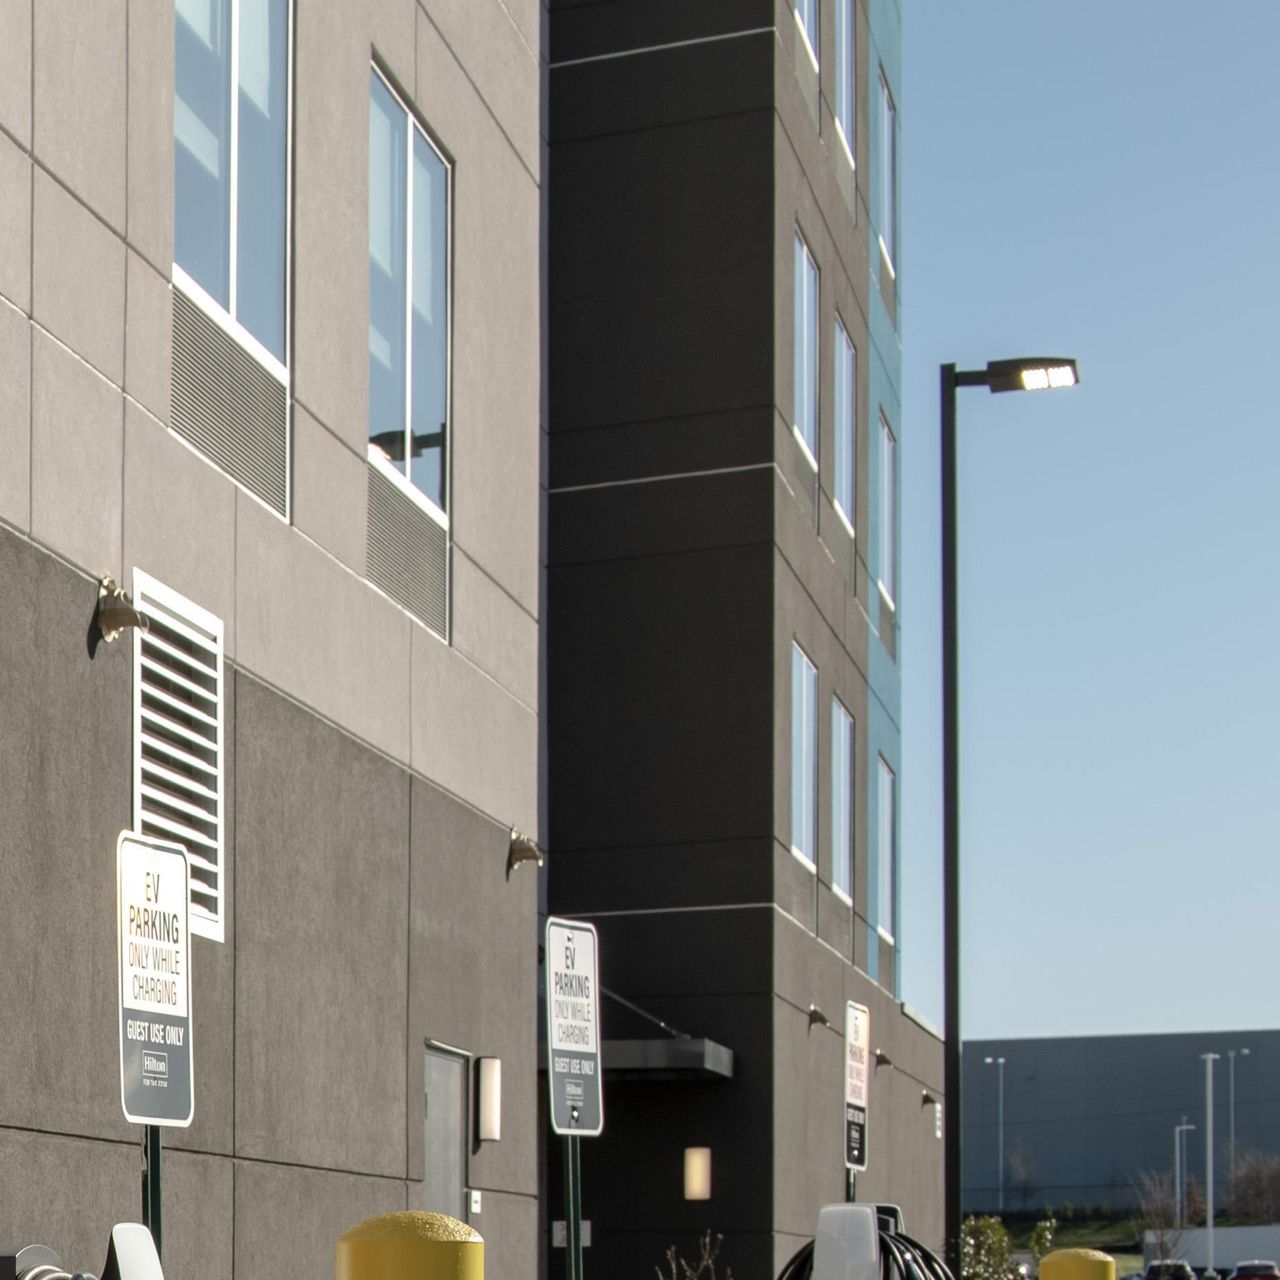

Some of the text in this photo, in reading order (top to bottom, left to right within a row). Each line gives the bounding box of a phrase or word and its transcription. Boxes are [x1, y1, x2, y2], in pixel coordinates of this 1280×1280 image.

[146, 872, 160, 903] EV
[129, 905, 179, 944] PARKING
[128, 942, 180, 975] ONLY WHILE
[565, 946, 575, 970] EV
[132, 974, 177, 1006] CHARGING
[554, 971, 589, 999] PARKING
[127, 1019, 184, 1046] GUEST USE ONLY
